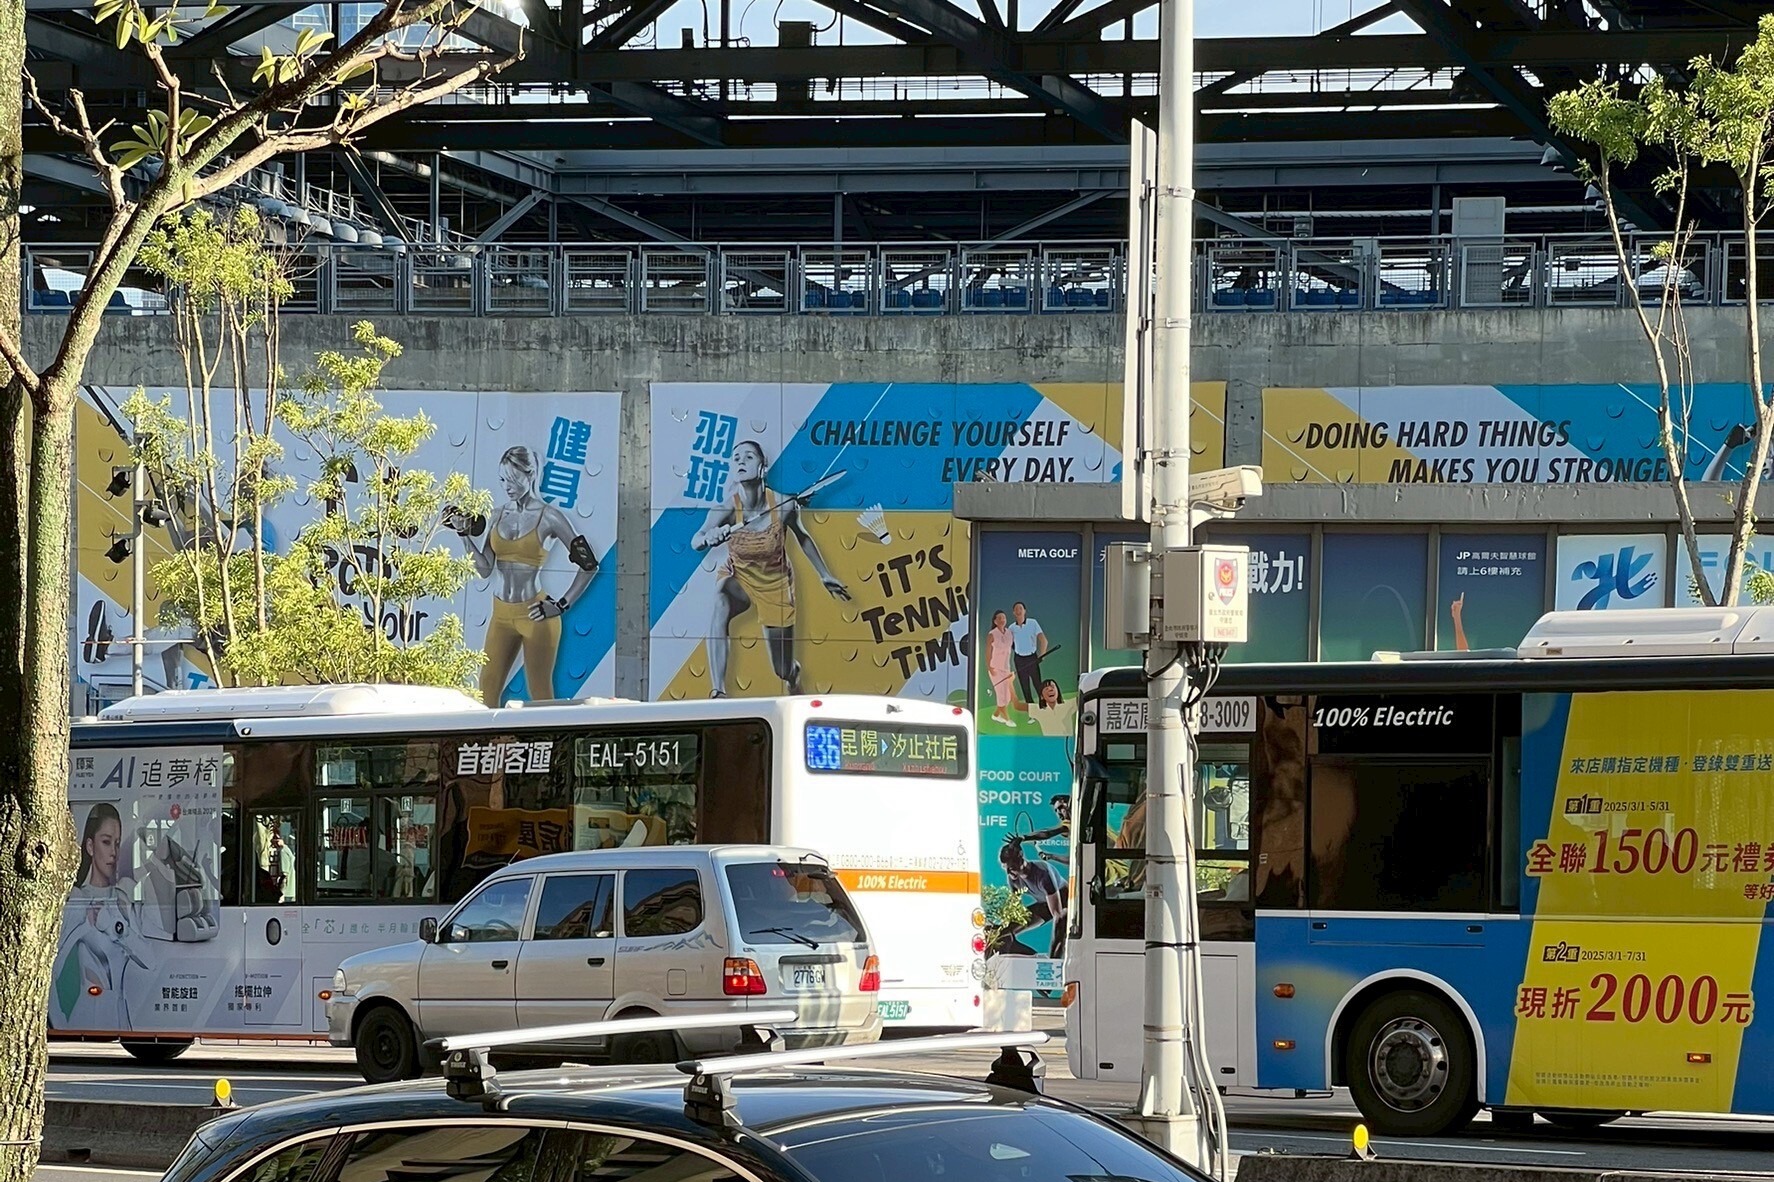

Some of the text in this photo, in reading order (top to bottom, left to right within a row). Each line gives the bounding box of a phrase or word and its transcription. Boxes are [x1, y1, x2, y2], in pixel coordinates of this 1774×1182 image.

[810, 420, 1070, 447] CHALLENGE YOURSELF
[1306, 420, 1572, 449] DOING HARD THINGS
[539, 416, 592, 509] 健身
[683, 410, 738, 503] 羽球
[942, 457, 1075, 482] EVERY DAY.
[1388, 458, 1475, 483] MAKES
[1486, 458, 1539, 483] YOU
[1018, 549, 1078, 558] META GOLF
[1313, 706, 1454, 727] 100% Electric
[457, 742, 553, 775] 首都客運
[590, 741, 679, 768] EAL-5151
[100, 756, 136, 788] AI
[980, 771, 1060, 782] FOOD COURT
[979, 791, 1042, 804] SPORTS
[979, 815, 1008, 827] LIFE
[857, 876, 927, 889] 100% Electric
